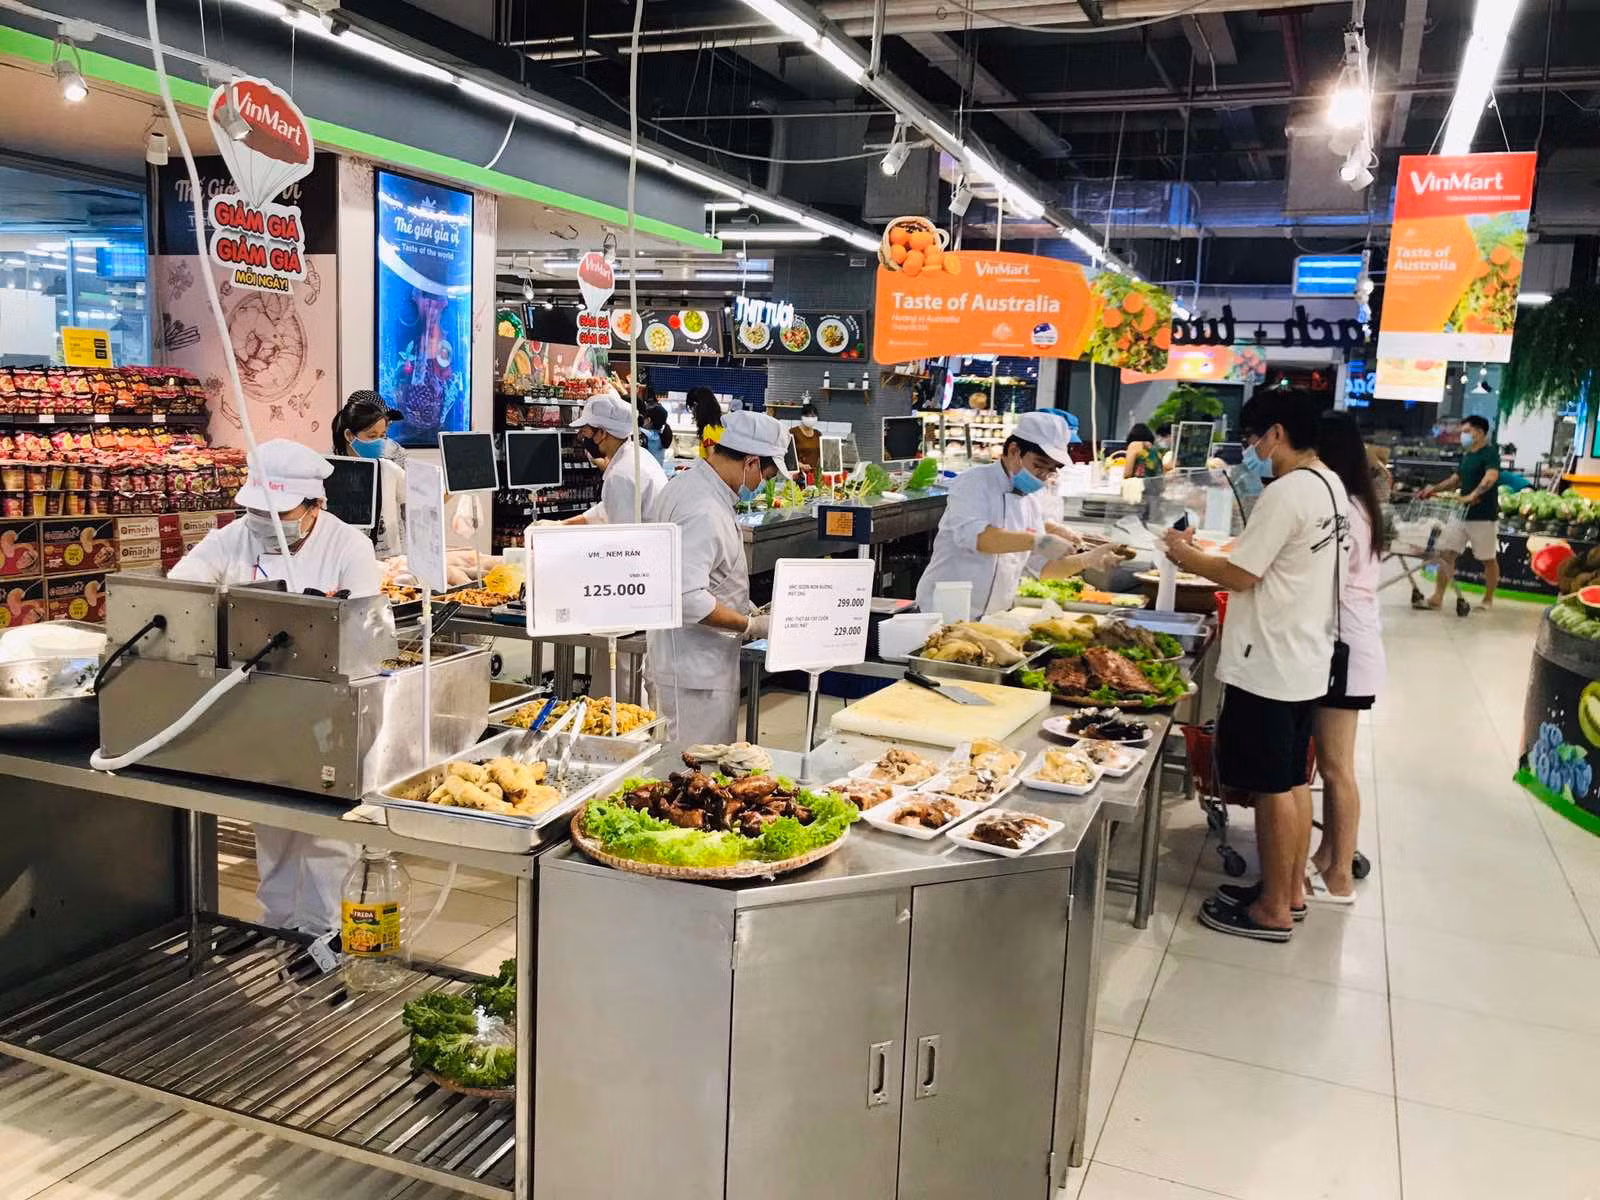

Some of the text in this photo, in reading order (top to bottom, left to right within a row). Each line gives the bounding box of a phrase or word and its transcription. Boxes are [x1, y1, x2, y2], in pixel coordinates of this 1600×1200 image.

[233, 87, 302, 145] VinMart
[1410, 170, 1503, 195] VinMart
[215, 200, 300, 242] GIẢM GIÁ
[394, 215, 417, 235] Thế
[414, 222, 433, 240] giới
[434, 223, 449, 244] gia
[216, 235, 302, 274] GIẢM GIÁ
[402, 242, 454, 260] Taste of the world
[1396, 246, 1452, 258] Taste of
[976, 261, 1030, 277] VinMart
[1394, 258, 1456, 271] Australia
[235, 267, 289, 292] MỖI NGÀY!
[891, 292, 1060, 313] Taste of Australia
[606, 550, 623, 558] NEM
[625, 548, 641, 557] RÁN
[583, 583, 646, 597] 125.000
[837, 598, 865, 607] 299.000
[834, 626, 861, 636] 229.000
